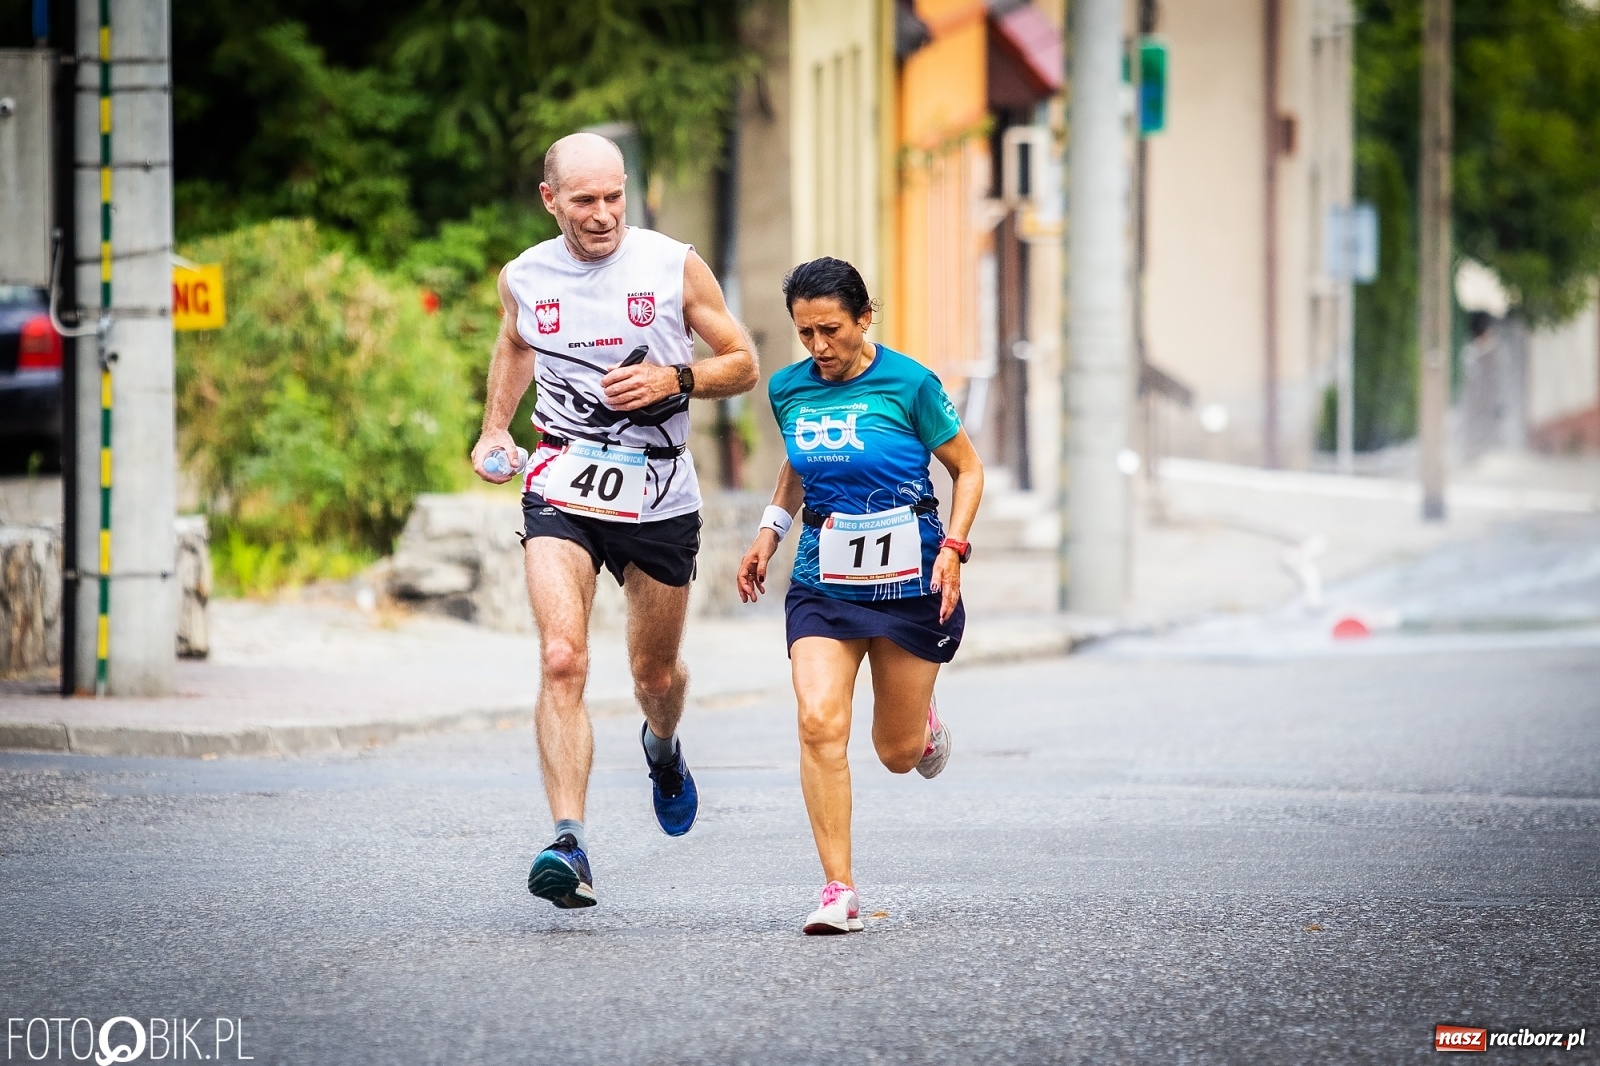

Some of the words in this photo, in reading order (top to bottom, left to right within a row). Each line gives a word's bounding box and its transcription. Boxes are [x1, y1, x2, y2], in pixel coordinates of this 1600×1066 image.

[795, 413, 864, 451] bbl
[573, 447, 590, 456] BIEG
[591, 450, 643, 464] KRZANOWICKI
[806, 453, 850, 463] RACIBÓRZ
[570, 464, 624, 502] 40
[839, 522, 857, 530] BIEG
[859, 514, 912, 530] KRZANOWICKI
[849, 532, 892, 568] 11
